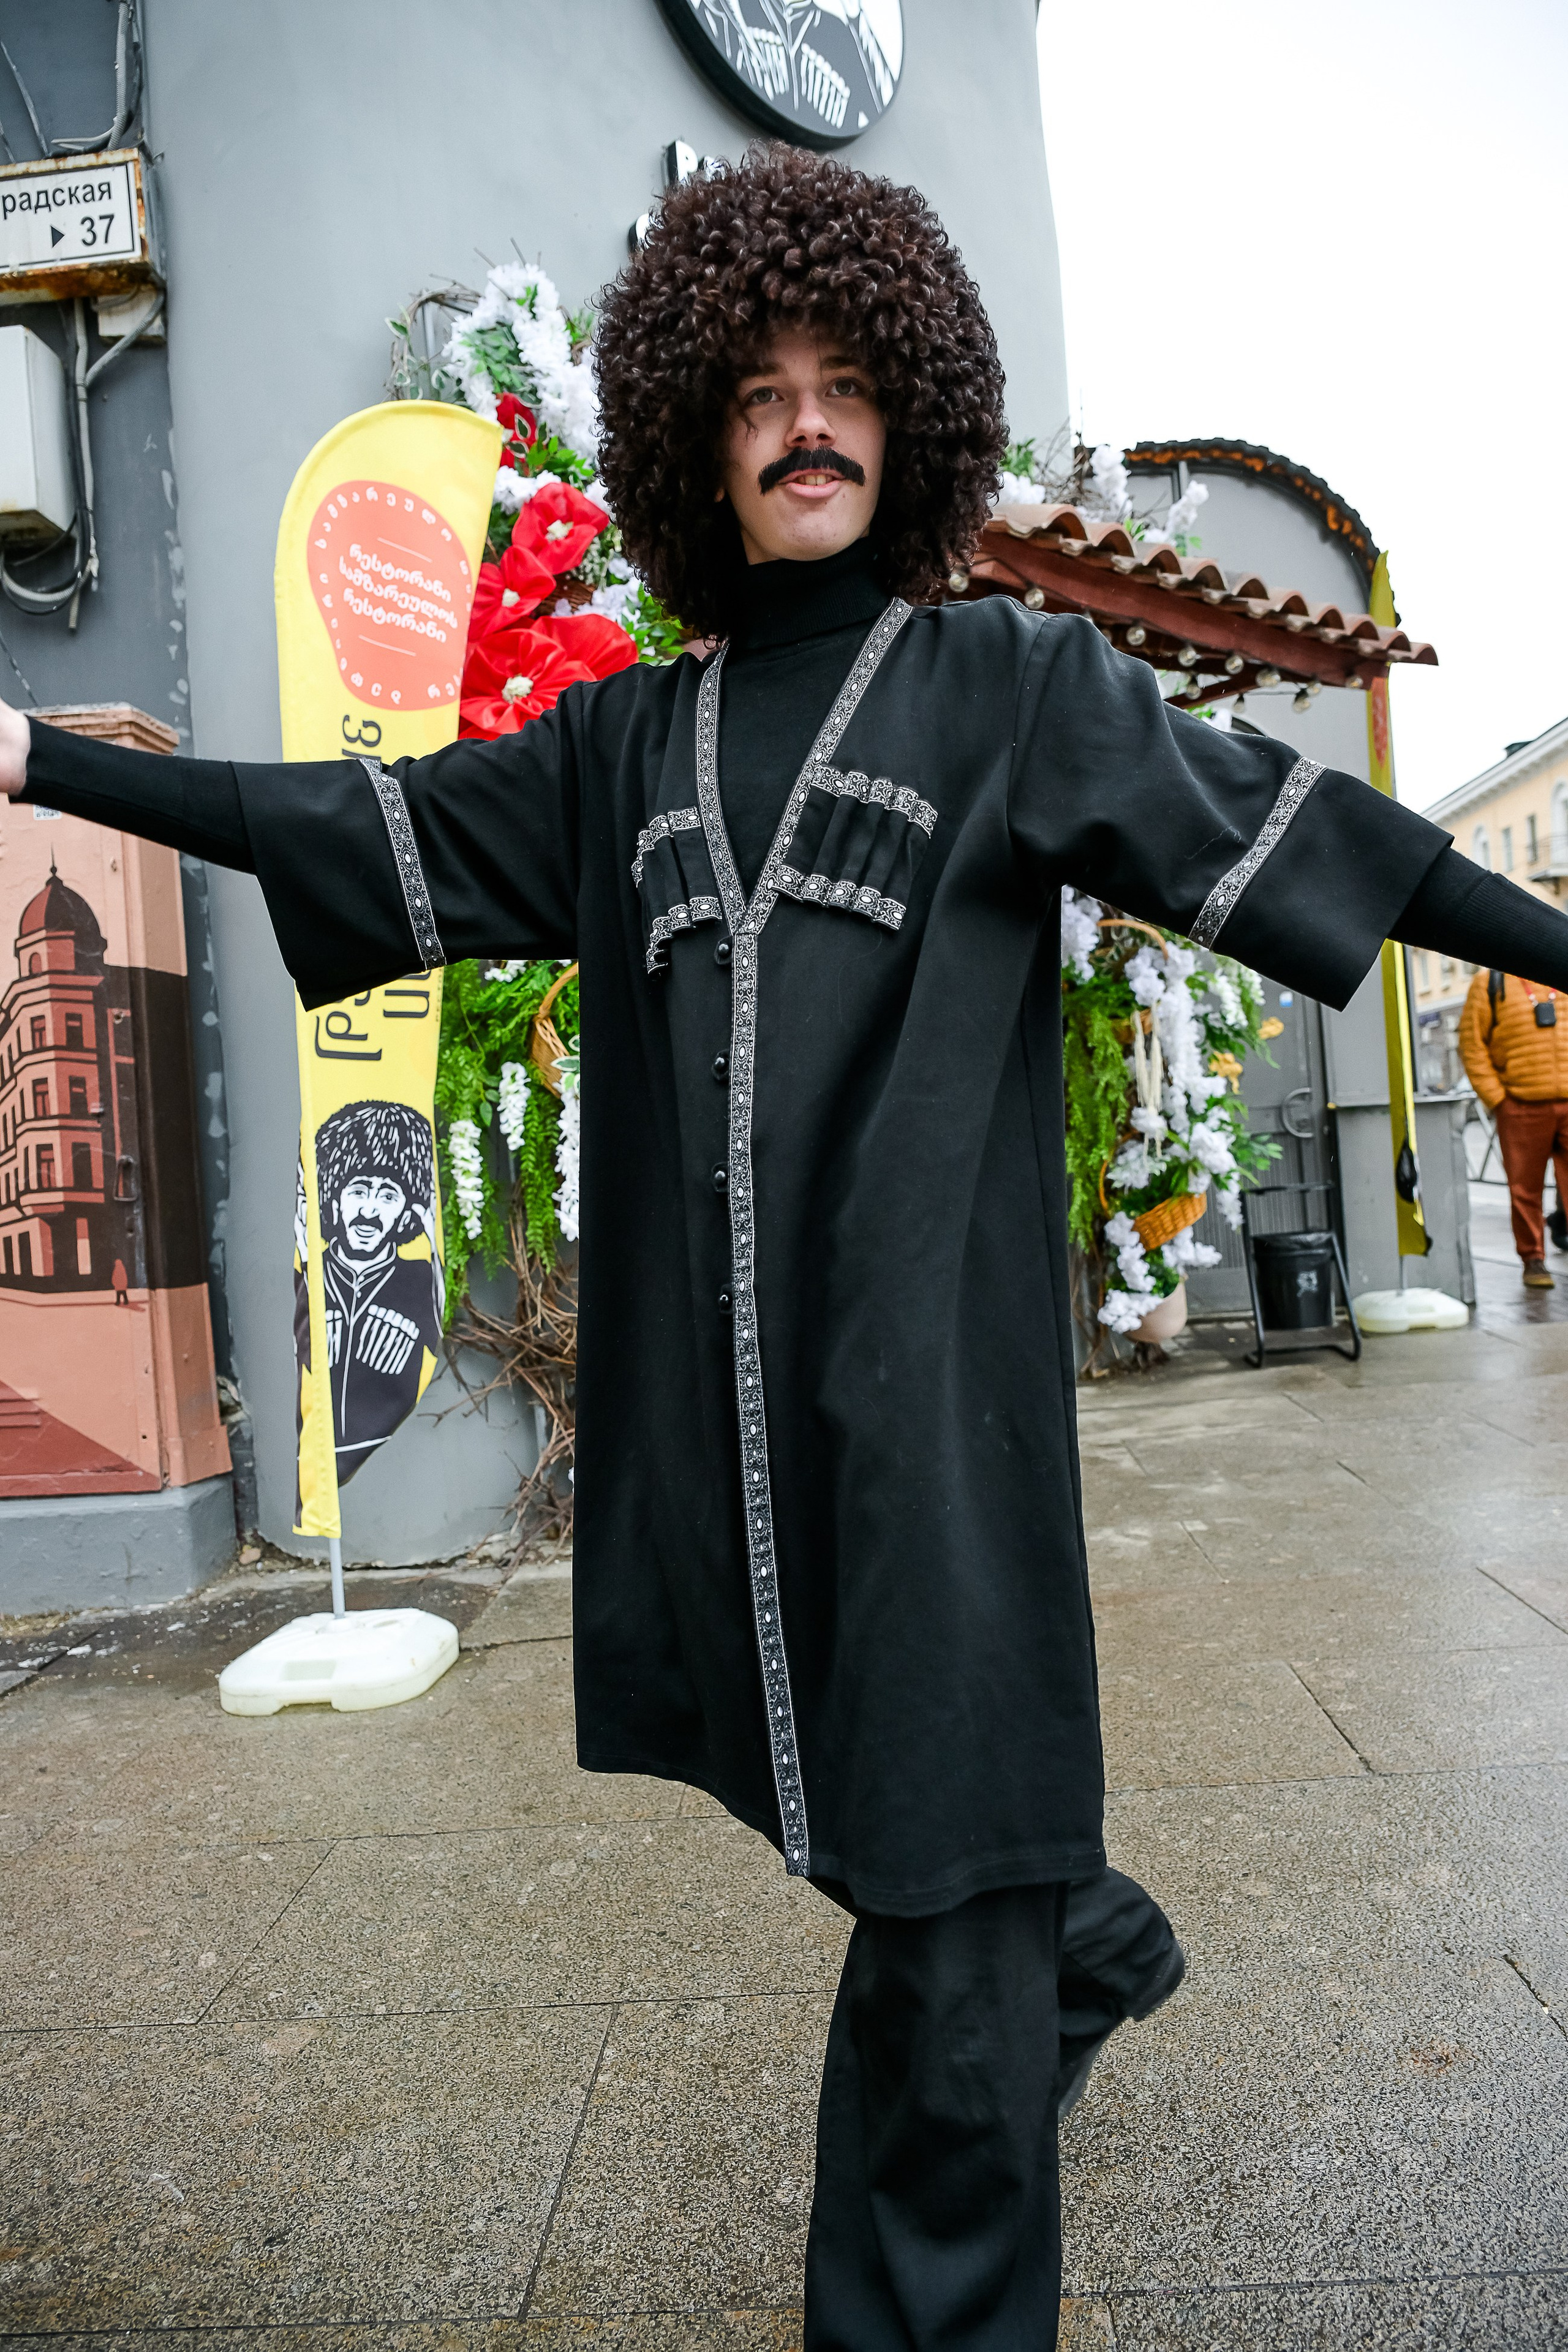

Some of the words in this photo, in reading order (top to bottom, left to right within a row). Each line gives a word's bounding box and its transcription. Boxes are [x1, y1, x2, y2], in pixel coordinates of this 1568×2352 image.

[2, 182, 111, 219] радская
[81, 214, 115, 246] 37
[350, 543, 451, 603] რესტორანი
[344, 587, 447, 643] რესტორანი
